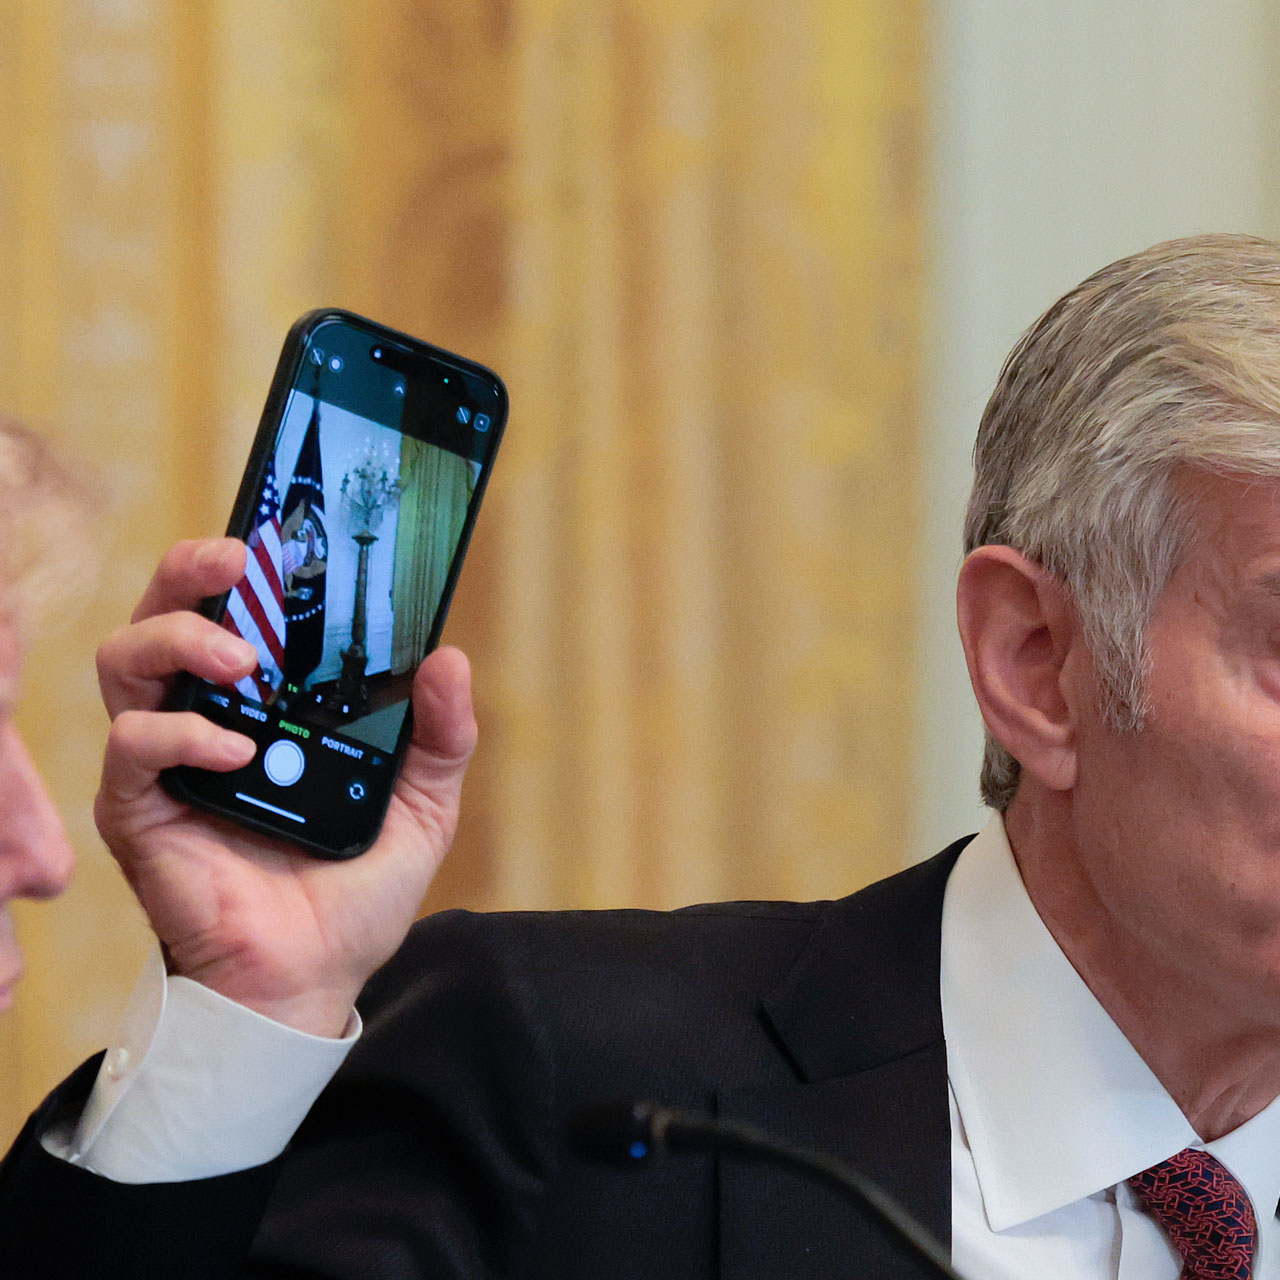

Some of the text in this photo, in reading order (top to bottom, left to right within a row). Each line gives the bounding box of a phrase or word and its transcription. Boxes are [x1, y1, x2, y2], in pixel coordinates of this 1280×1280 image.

[240, 704, 365, 760] VIDEO PHOTO PORTRAIT
